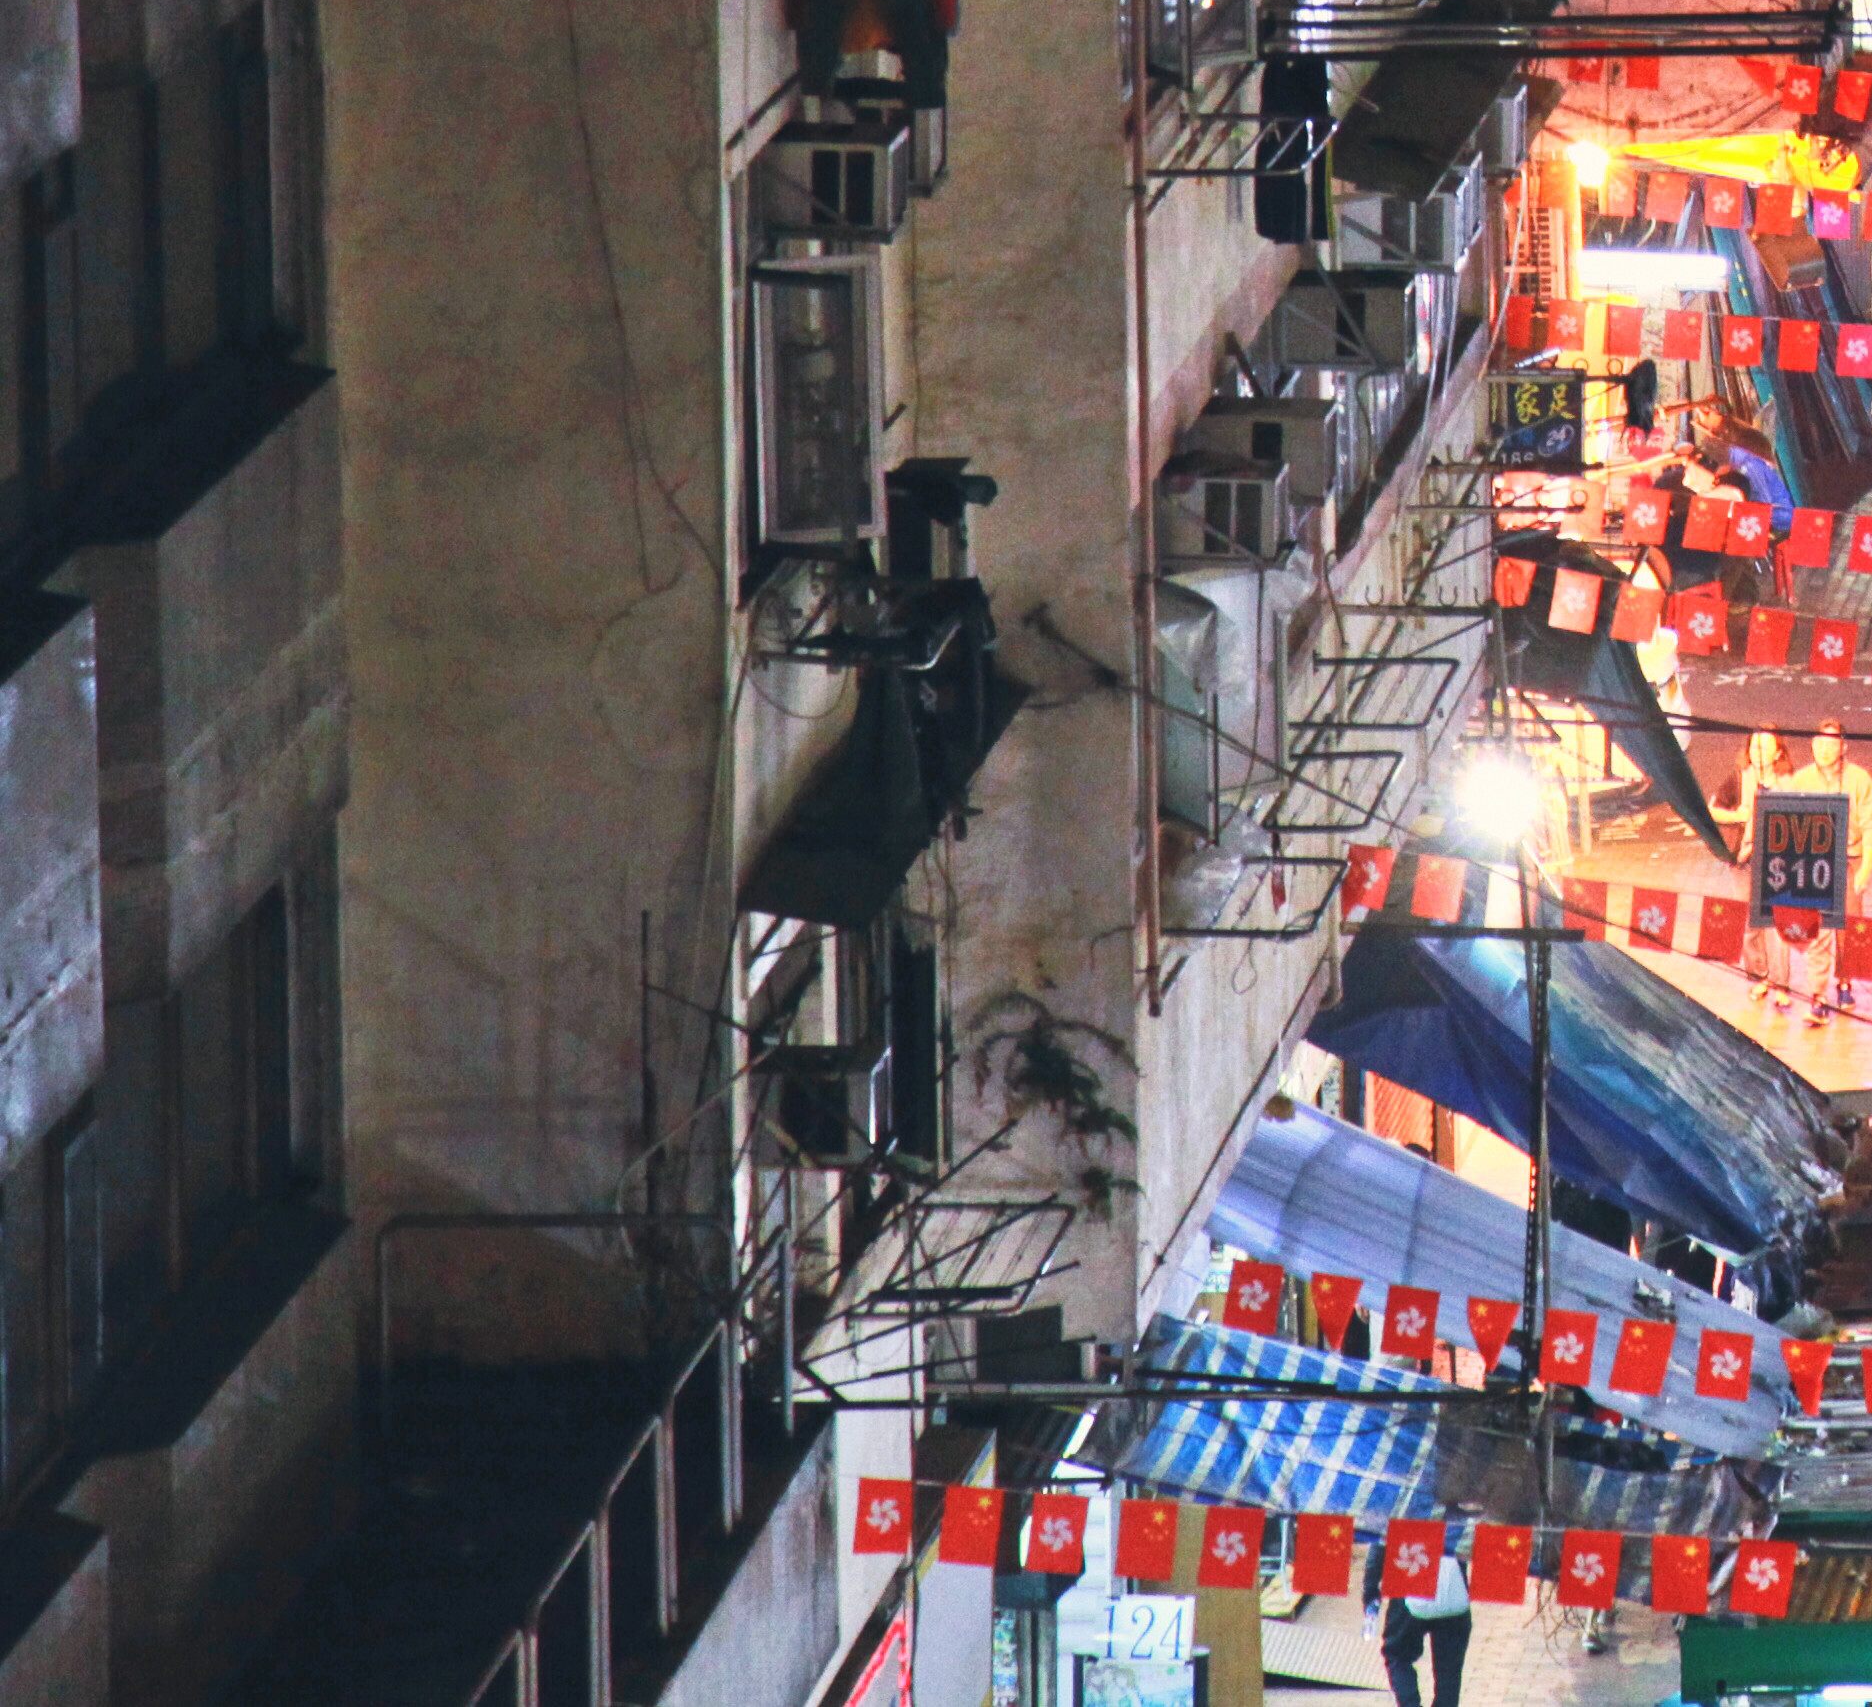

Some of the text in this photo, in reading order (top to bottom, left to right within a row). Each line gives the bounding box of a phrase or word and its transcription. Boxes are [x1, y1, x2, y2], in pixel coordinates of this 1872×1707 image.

[1768, 813, 1834, 855] DVD
[1766, 857, 1832, 892] $10
[1103, 1603, 1187, 1660] 124
